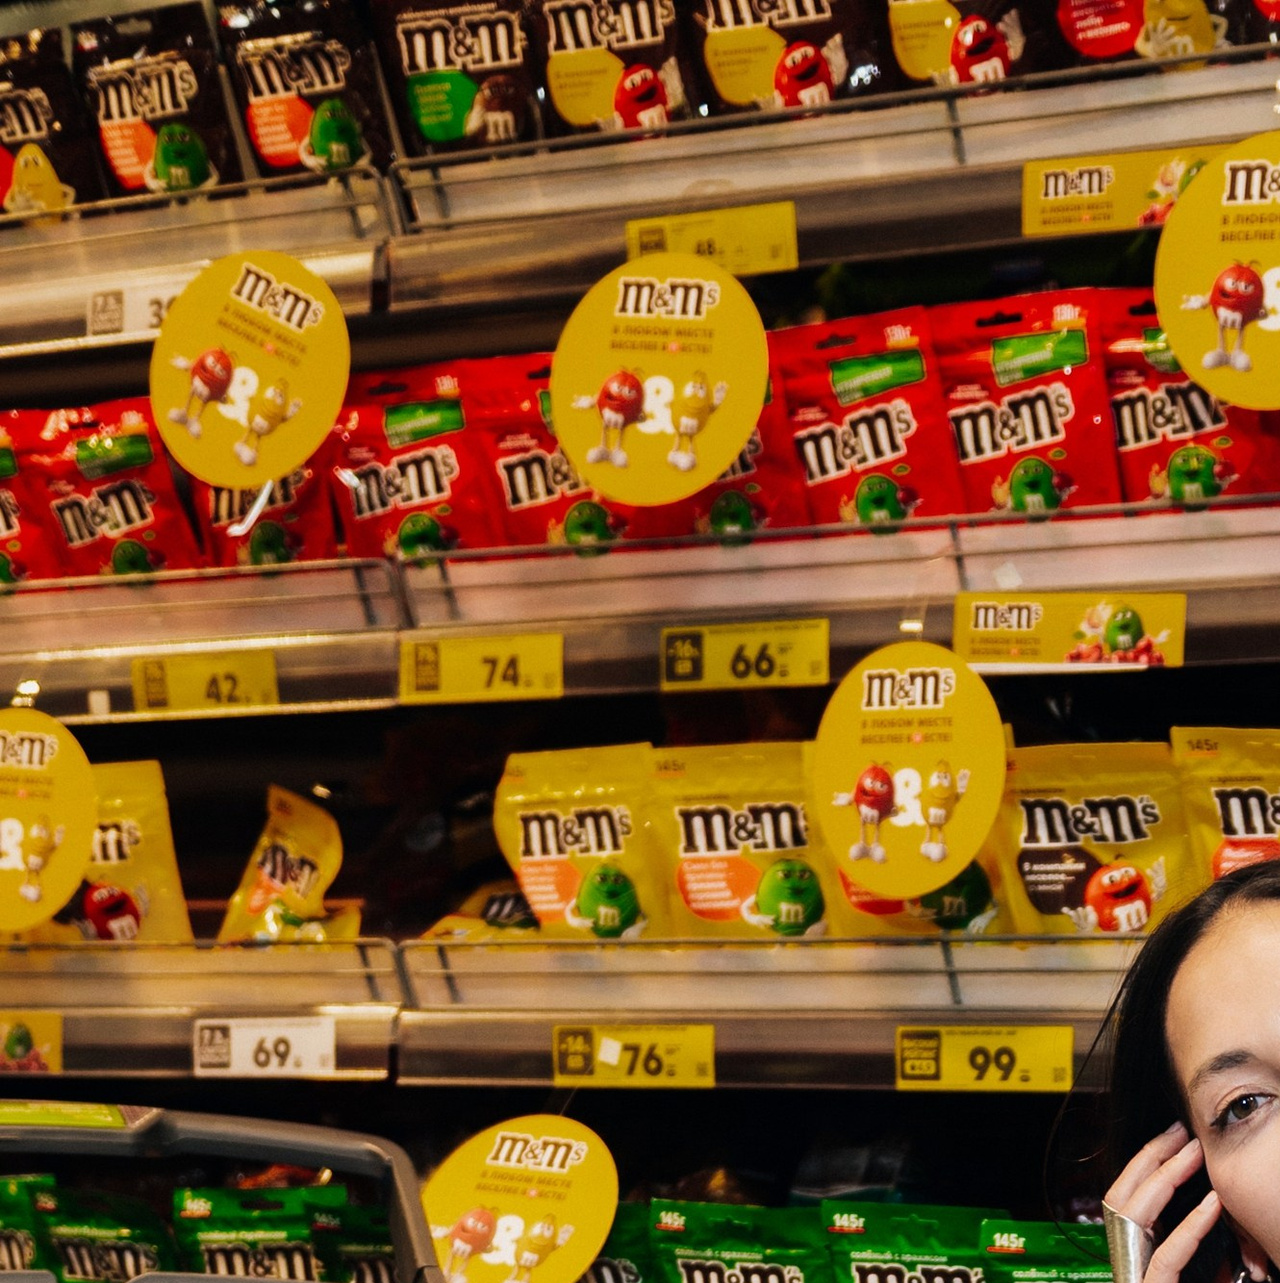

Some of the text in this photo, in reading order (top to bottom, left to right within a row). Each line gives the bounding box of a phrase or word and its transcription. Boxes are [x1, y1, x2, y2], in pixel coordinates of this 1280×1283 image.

[400, 10, 526, 74] m&m
[795, 398, 917, 486] m&m's
[948, 382, 1073, 465] m&m's
[483, 655, 519, 687] 74
[730, 643, 776, 679] 66
[862, 667, 956, 711] m&m's
[676, 801, 808, 857] m&m
[1020, 794, 1161, 848] m&m's
[252, 1036, 292, 1069] 69
[622, 1043, 664, 1076] 76
[968, 1045, 1017, 1082] 99
[487, 1131, 589, 1174] m&m's
[833, 1213, 866, 1228] 145г
[993, 1232, 1026, 1248] 145г
